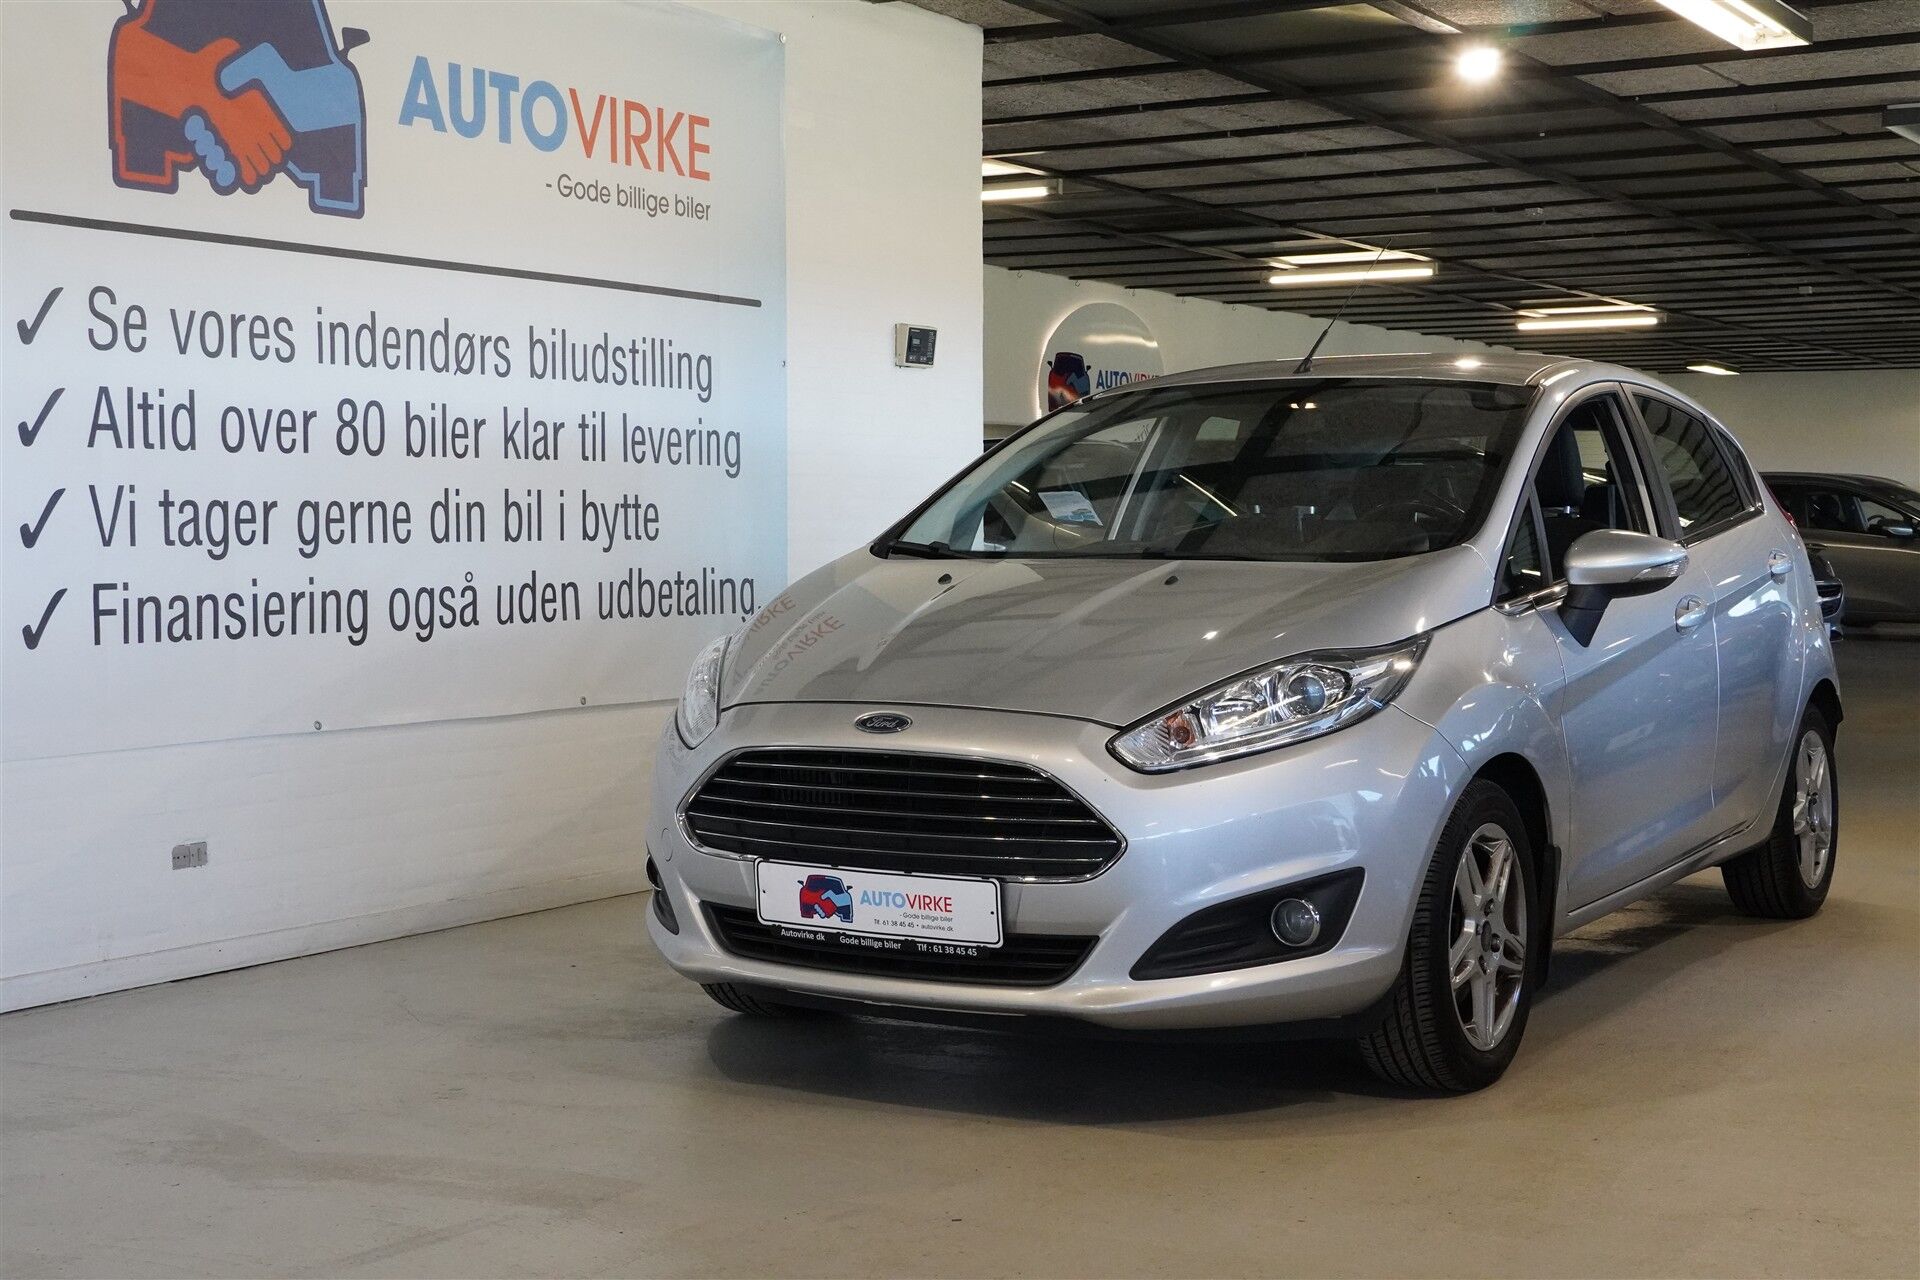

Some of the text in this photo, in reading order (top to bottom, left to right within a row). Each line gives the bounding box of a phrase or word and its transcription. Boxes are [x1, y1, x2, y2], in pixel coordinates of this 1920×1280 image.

[398, 55, 711, 182] AUTOVIRKE
[557, 173, 611, 205] Gode
[616, 183, 670, 218] billige
[674, 193, 711, 221] biler
[87, 285, 713, 404] Se vores indendørs biludstilling
[87, 385, 741, 479] Altid over 80 biler klar til levering
[88, 484, 660, 561] Vi tager gerne din bil i bytte
[92, 576, 369, 647] Finansiering
[388, 570, 480, 643] også
[496, 569, 581, 626] uden
[866, 716, 900, 728] Ford
[860, 889, 953, 913] AUTOVIRKE
[903, 912, 920, 920] Gode
[840, 936, 860, 945] Gode
[860, 938, 883, 949] billige
[884, 940, 902, 949] biler
[933, 945, 943, 953] 61
[945, 946, 955, 954] 38
[956, 947, 966, 955] 45
[967, 948, 978, 956] 45
